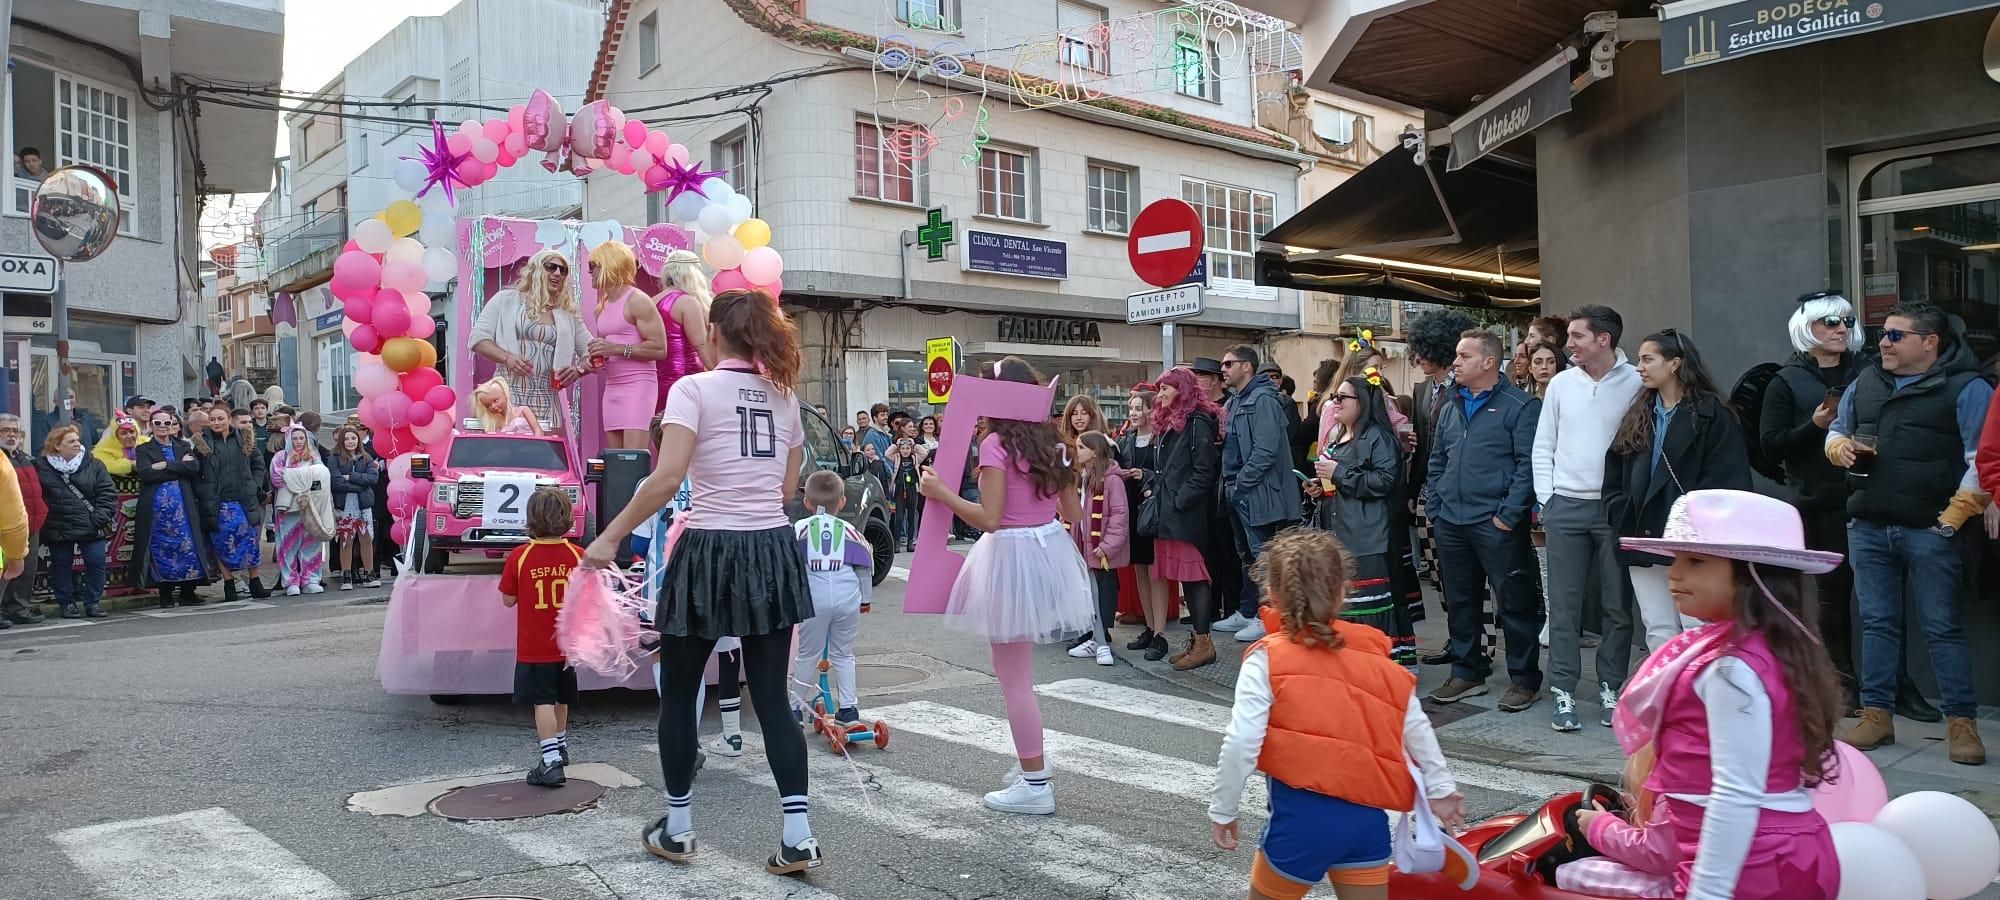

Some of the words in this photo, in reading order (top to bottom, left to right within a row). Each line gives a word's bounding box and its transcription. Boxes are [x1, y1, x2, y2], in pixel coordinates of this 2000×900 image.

[1757, 0, 1849, 25] BODEGA
[1728, 23, 1793, 49] Estrella
[1796, 8, 1861, 33] Galicia
[972, 233, 1000, 248] CLÍNICA
[1003, 238, 1030, 251] DENTAL
[1141, 291, 1185, 304] EXCEPTO
[1130, 307, 1161, 319] CAMION
[1165, 302, 1197, 314] BASURA
[32, 320, 46, 329] 66
[998, 317, 1101, 343] FARMACIA
[738, 388, 768, 404] MESSI
[736, 405, 776, 458] 10
[497, 483, 520, 514] 2
[530, 564, 574, 579] ESPAÑA
[534, 579, 569, 610] 10
